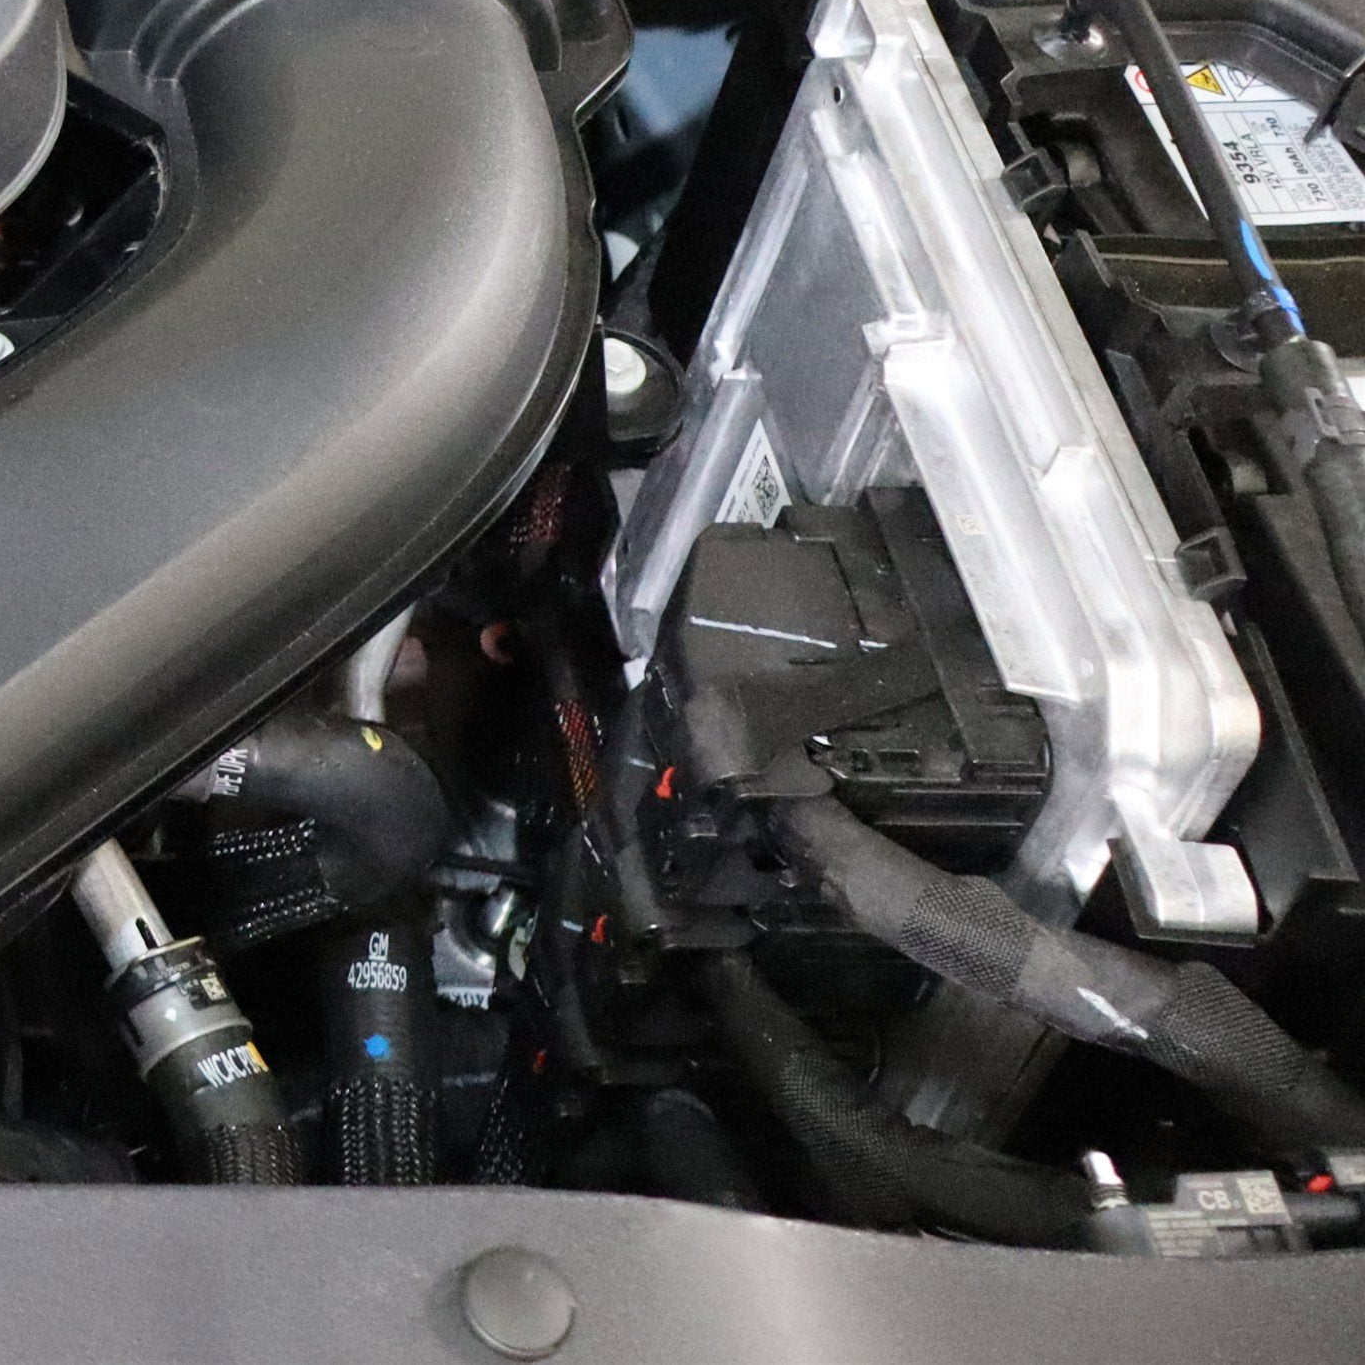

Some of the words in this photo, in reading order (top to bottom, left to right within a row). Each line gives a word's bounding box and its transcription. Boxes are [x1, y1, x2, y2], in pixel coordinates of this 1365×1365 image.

[1265, 117, 1285, 138] 730
[1222, 141, 1261, 184] 9354
[1240, 132, 1268, 166] VRLA
[1285, 147, 1309, 175] 80Ah
[1262, 168, 1283, 190] 12V
[1306, 182, 1327, 203] 730
[368, 931, 390, 960] GM
[347, 961, 408, 993] 42956859
